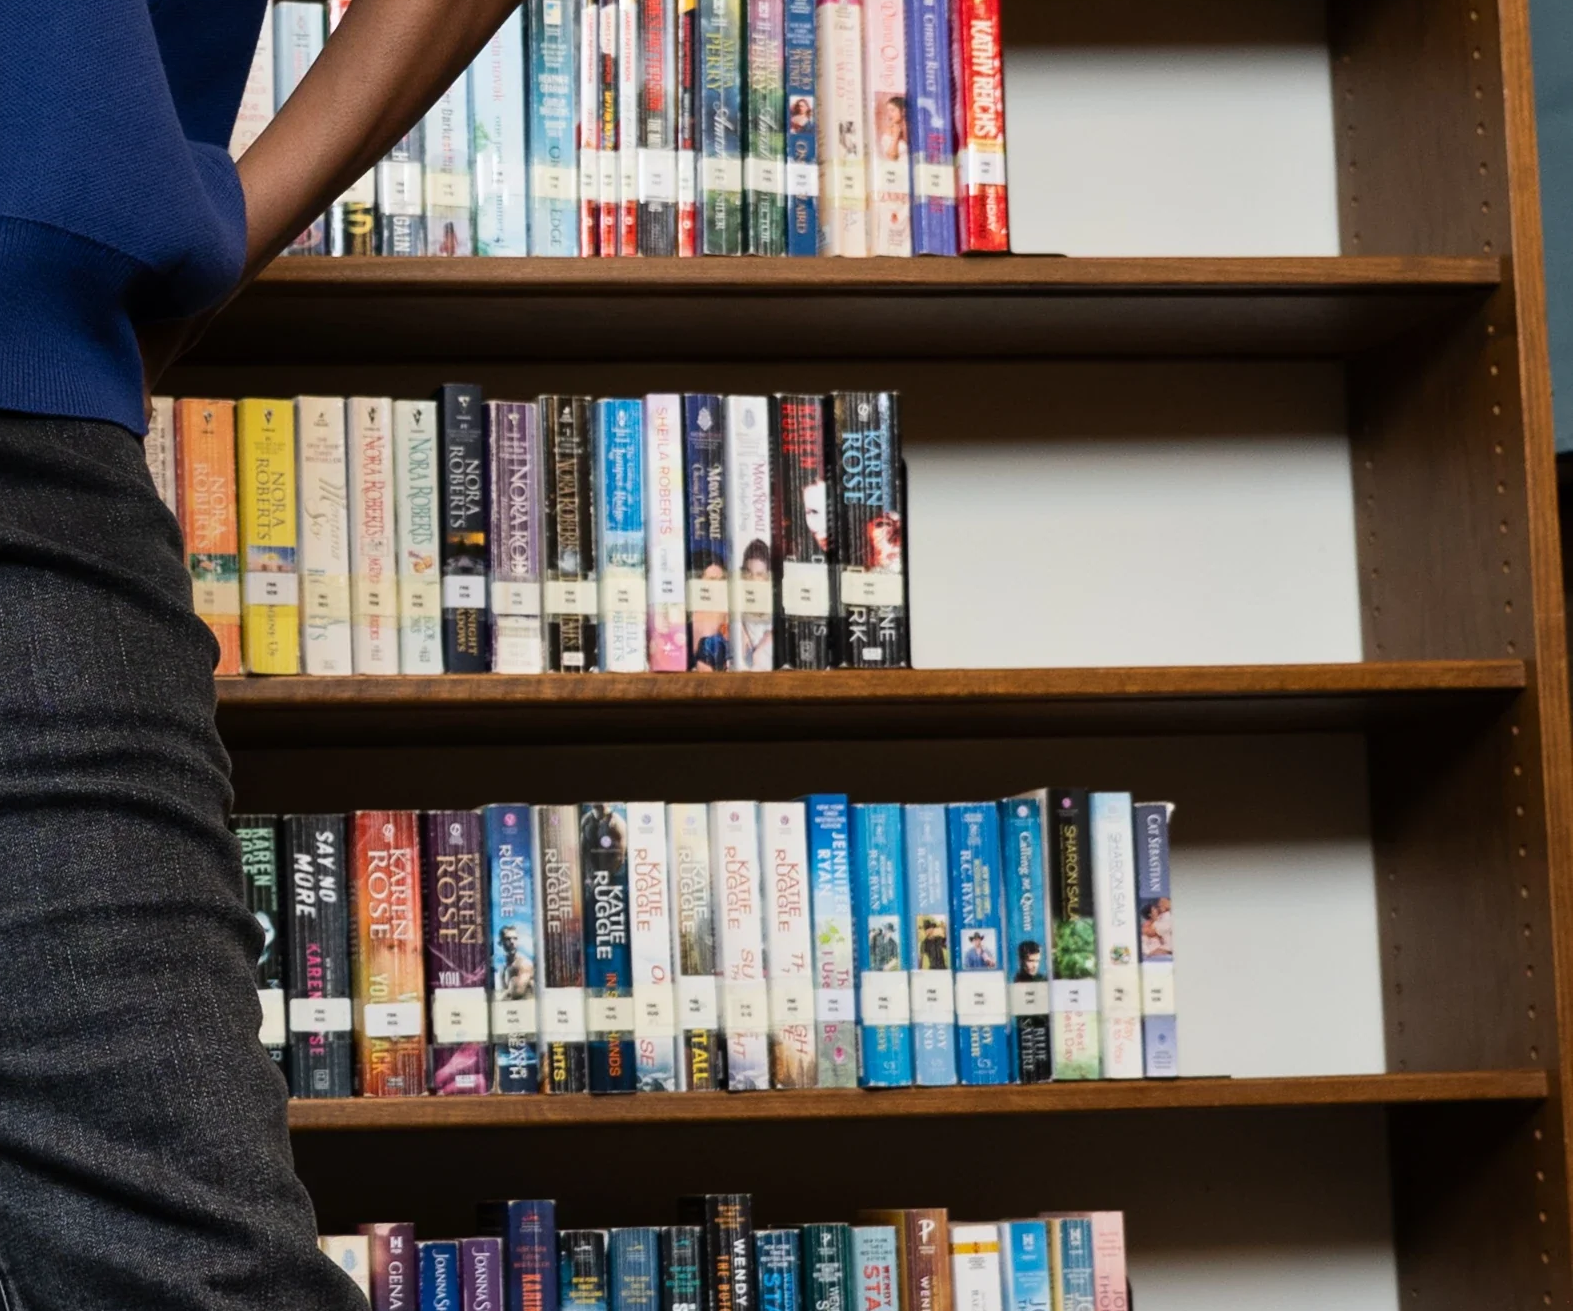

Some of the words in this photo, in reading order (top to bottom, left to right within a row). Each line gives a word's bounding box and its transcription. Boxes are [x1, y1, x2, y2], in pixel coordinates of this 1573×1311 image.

[706, 32, 722, 91] PERRY
[970, 19, 996, 74] KATHY
[972, 77, 998, 137] REICHS
[655, 407, 670, 461] SHEILA
[448, 446, 467, 528] ROBERTS
[464, 458, 481, 515] NORA
[841, 430, 863, 506] ROSE
[863, 429, 884, 506] KAREN
[657, 466, 673, 535] ROBERTS
[315, 831, 335, 867] SAY
[817, 848, 833, 897] RYAN
[293, 853, 316, 918] MORE
[319, 875, 337, 903] NO
[593, 870, 612, 960] RUGGLE
[607, 885, 625, 945] KATIE
[387, 1261, 403, 1309] GENA
[733, 1239, 748, 1306] WENDY
